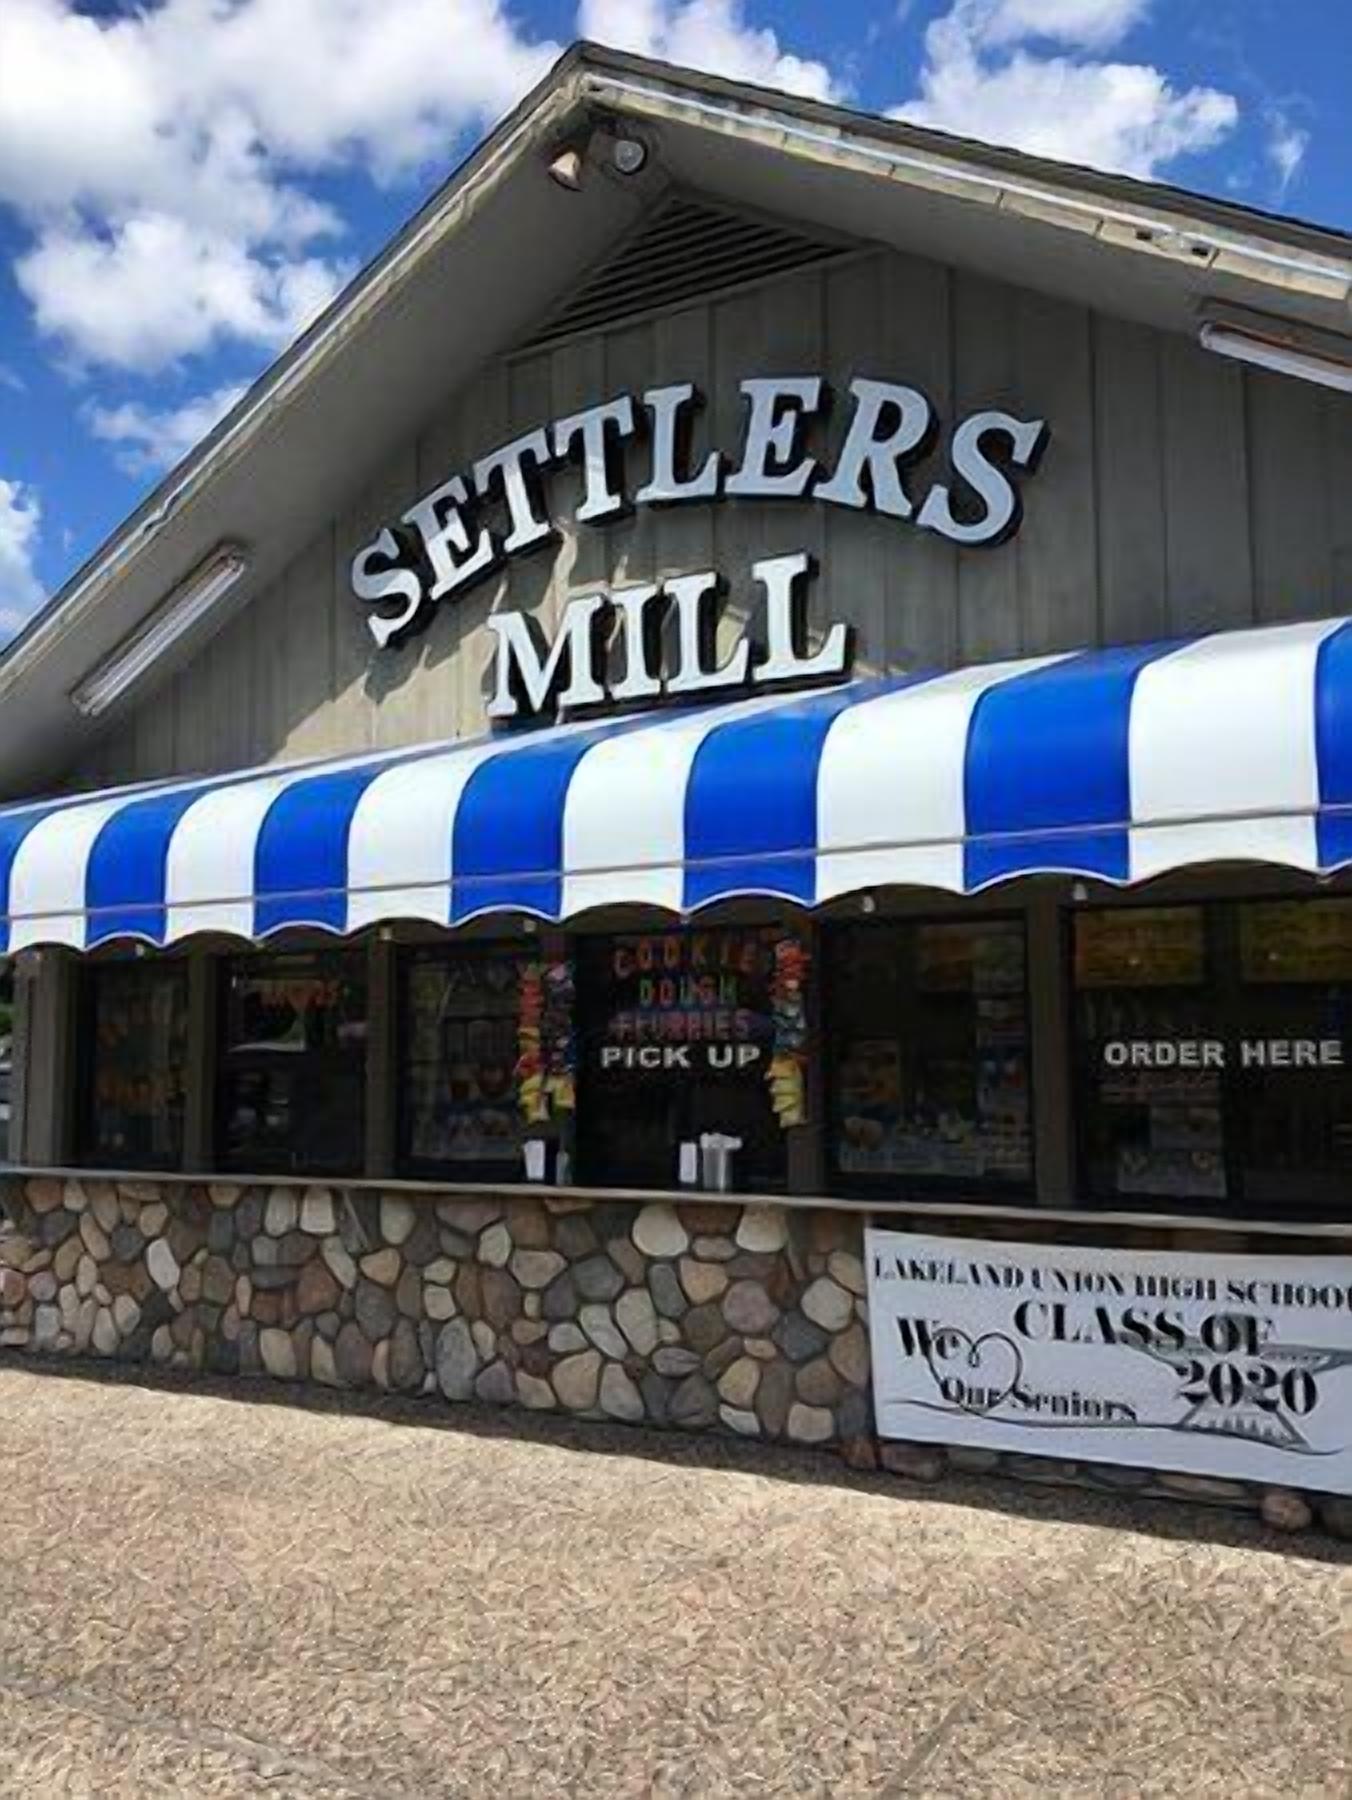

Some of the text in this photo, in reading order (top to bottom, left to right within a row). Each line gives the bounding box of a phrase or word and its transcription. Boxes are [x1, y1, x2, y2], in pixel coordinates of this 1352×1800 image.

[350, 375, 1049, 648] SETTLERS
[489, 552, 847, 718] MILL
[602, 1046, 760, 1068] PICK UP
[1103, 1039, 1345, 1067] ORDER HERE
[874, 1255, 1024, 1289] LAKELAND
[1031, 1266, 1124, 1297] UNION
[1136, 1275, 1216, 1301] HIGH
[896, 1316, 960, 1361] We
[1013, 1299, 1278, 1356] CLASS OF
[940, 1376, 1138, 1420] Our Seniors
[1174, 1360, 1318, 1416] 2020
